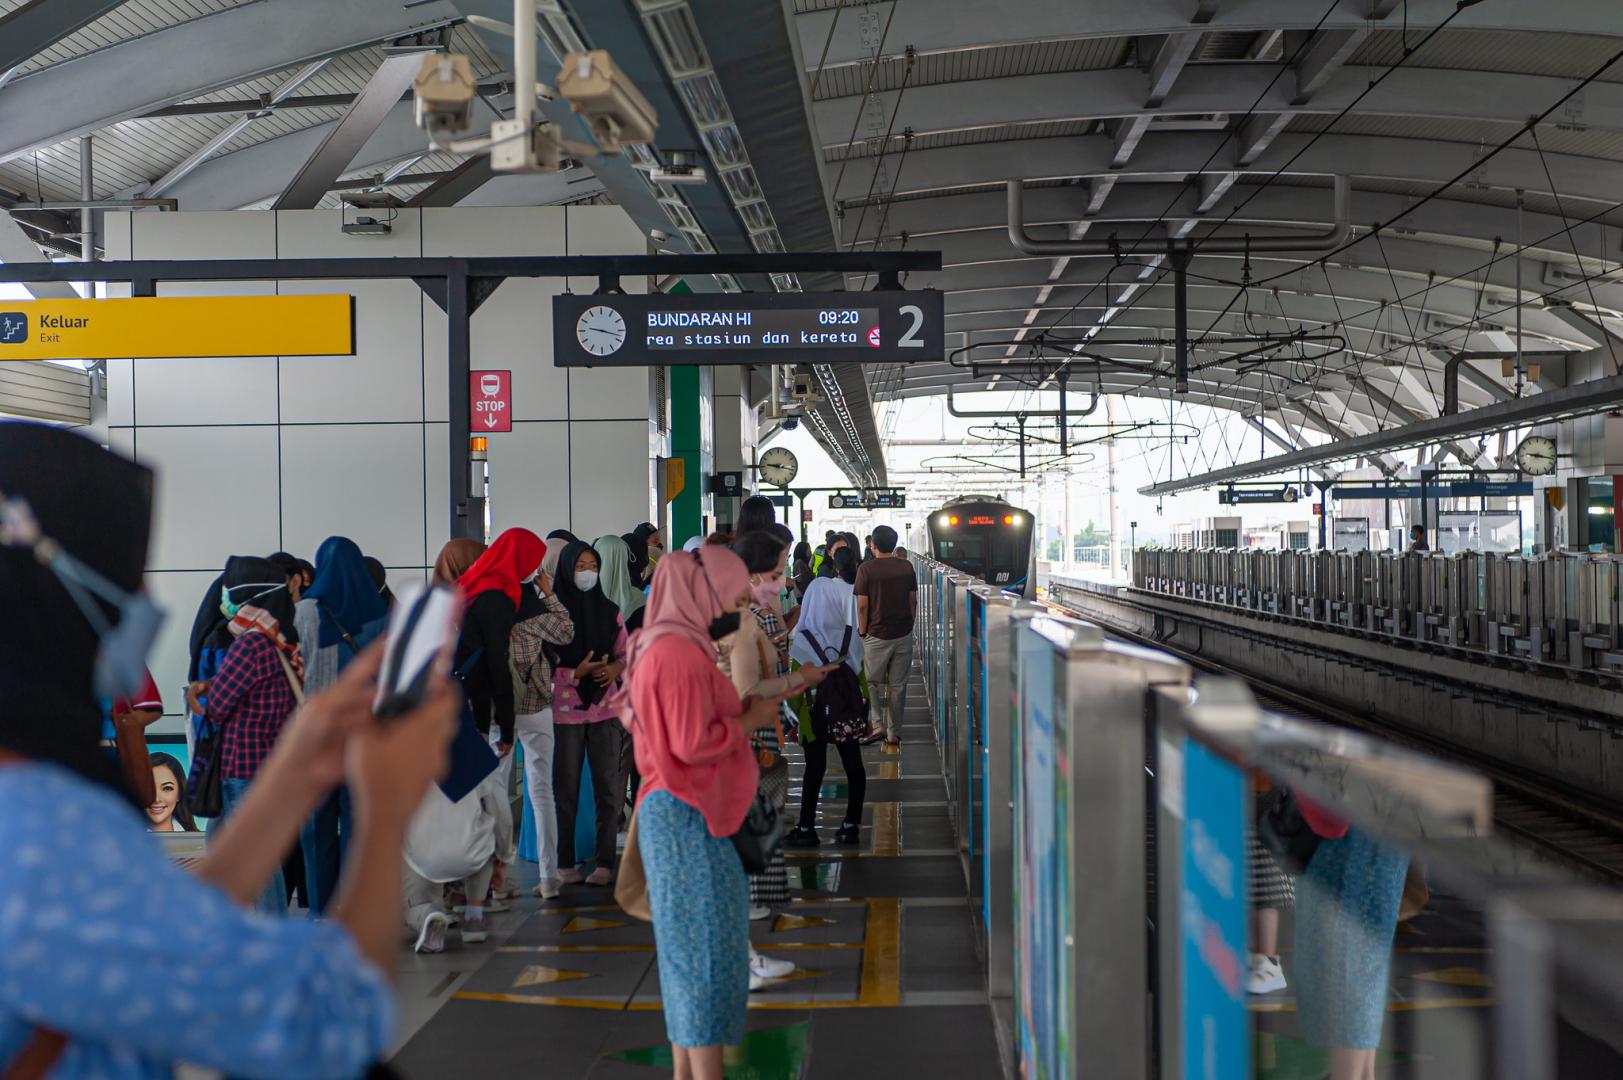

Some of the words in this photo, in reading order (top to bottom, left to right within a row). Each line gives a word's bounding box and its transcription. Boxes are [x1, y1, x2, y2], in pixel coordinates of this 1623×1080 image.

[40, 315, 89, 328] Keluar
[647, 312, 733, 327] BUNDARAN
[737, 312, 751, 326] HI
[819, 311, 859, 324] 09:20
[897, 305, 925, 348] 2
[40, 333, 60, 343] Exit
[684, 332, 751, 344] stasiun
[762, 331, 789, 344] dan
[800, 330, 858, 343] kereta
[476, 400, 505, 412] STOP
[896, 497, 902, 506] 2
